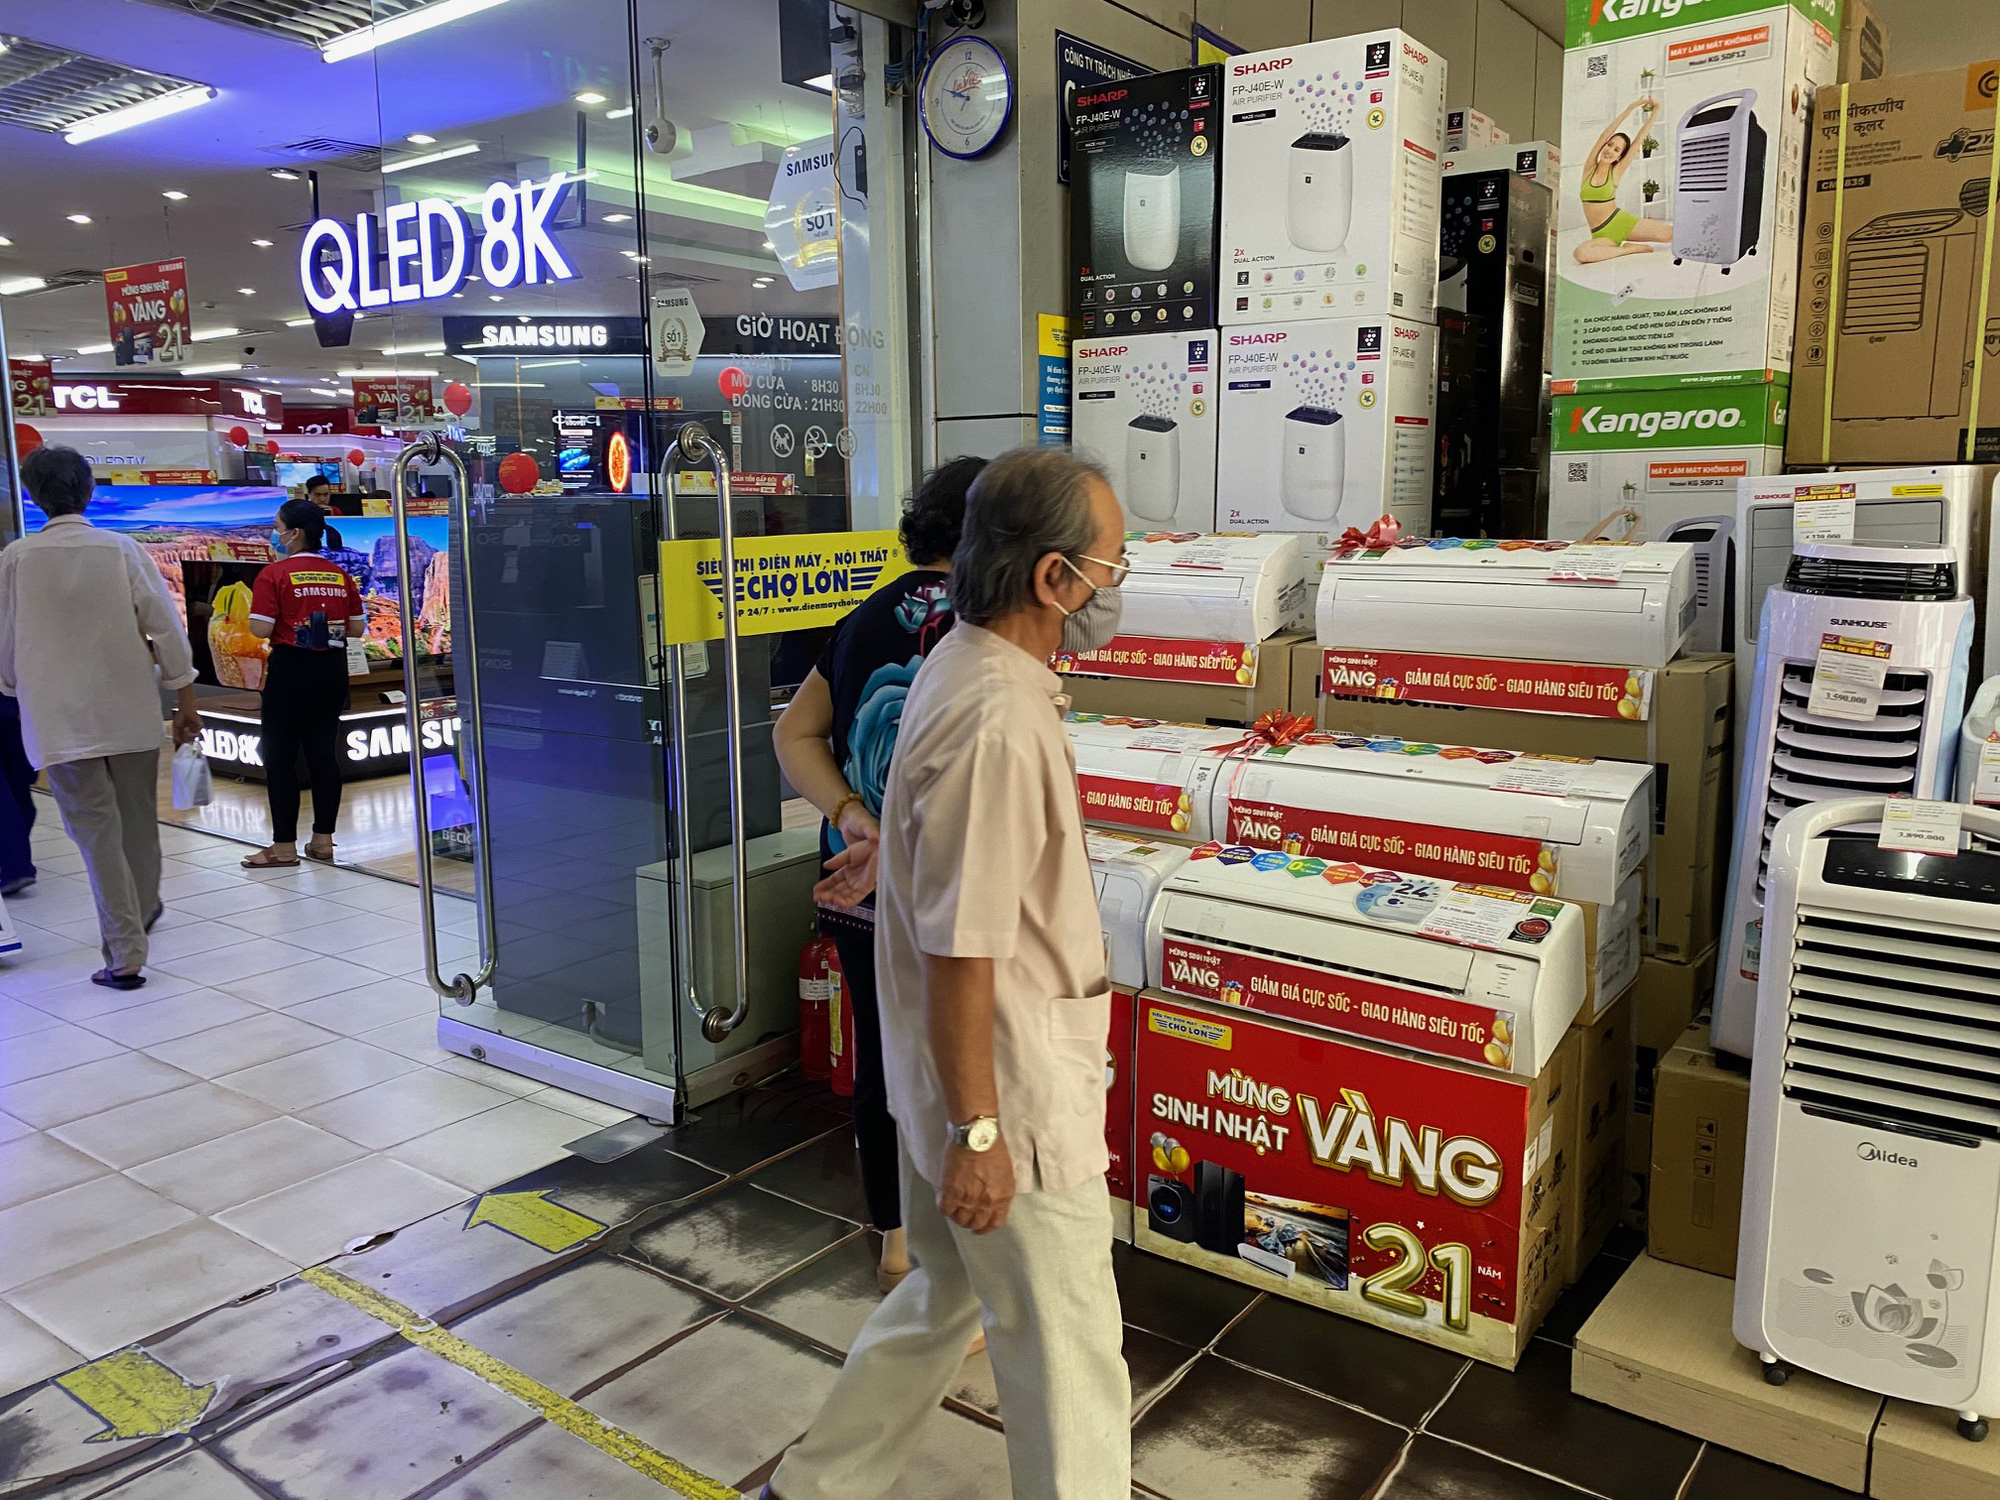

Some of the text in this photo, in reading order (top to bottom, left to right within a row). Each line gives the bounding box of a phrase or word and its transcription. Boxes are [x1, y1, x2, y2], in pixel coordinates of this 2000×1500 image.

[965, 51, 972, 60] 12
[1403, 43, 1428, 66] SHARP
[1233, 58, 1293, 77] SHARP
[1232, 79, 1285, 96] FP-J40E-W
[935, 98, 939, 107] 9
[1077, 89, 1128, 108] SHARP
[1232, 92, 1283, 107] AIR PURIFIER
[1076, 109, 1122, 125] FP-J40E-W
[965, 137, 970, 146] 6
[300, 172, 572, 313] QLED 8K
[1234, 249, 1245, 257] 2x
[1080, 267, 1091, 275] 2x
[1096, 273, 1116, 281] ACTION
[128, 296, 166, 322] VÀNG
[657, 298, 689, 309] SAMSUNG
[157, 322, 184, 362] 21
[482, 325, 608, 346] SAMSUNG
[666, 327, 682, 343] SỐ 1
[779, 320, 830, 347] HOẠT
[1229, 332, 1287, 346] SHARP
[1394, 327, 1420, 340] SHARP
[1078, 346, 1129, 359] SHARP
[1228, 352, 1279, 365] FP-J40E-W
[778, 358, 793, 372] T7
[1078, 365, 1122, 375] FP-J40E-W
[1228, 364, 1278, 374] AIR PURIFIER
[811, 378, 839, 394] 8H30
[1078, 375, 1121, 385] AIR PURIFIER
[17, 394, 46, 416] 21
[52, 386, 120, 409] TCL
[241, 391, 267, 416] TCL
[376, 390, 411, 404] VÀNG
[732, 392, 888, 415] ĐÓNG CỬA 21H30 22H00
[401, 405, 425, 423] 21
[1568, 406, 1741, 439] Kangaroo
[1651, 463, 1745, 475] MÁY LÀM MÁT KHÔNG KHÍ
[1688, 479, 1699, 487] KG
[1229, 509, 1241, 518] 2x
[1229, 517, 1246, 525] DUAL
[759, 554, 792, 574] ĐIỆN
[795, 551, 822, 569] MÁY
[834, 549, 857, 568] NỘI
[860, 546, 888, 563] THẤT
[294, 587, 348, 598] SAMSUNG
[747, 565, 849, 603] CHỢ LỚN
[1830, 618, 1888, 629] SUNHOUSE
[1098, 648, 1113, 663] GIÁ
[1113, 651, 1129, 666] CỰC
[1130, 648, 1147, 666] SỐC
[1153, 653, 1173, 667] GIAO
[1174, 651, 1198, 668] HÀNG
[1199, 654, 1218, 670] SIÊU
[1221, 654, 1237, 671] TỐC
[1328, 666, 1377, 687] VÀNG
[1405, 667, 1619, 702] GIẢM GIÁ CỰC SỐC GIAO HÀNG SIÊU TỐC
[1825, 692, 1867, 705] 3.590.000
[238, 734, 264, 767] 8K
[1086, 791, 1173, 816] GIAO HÀNG SIÊU TỐC
[1267, 810, 1283, 821] NHẬT
[1310, 824, 1531, 876] GIẢM GIÁ CỰC SỐC GIAO HÀNG SIÊU TỐC
[1394, 883, 1430, 898] 24
[1169, 947, 1222, 967] MỪNG SINH NHẬT
[1168, 958, 1220, 989] VÀNG
[1250, 974, 1486, 1045] GIẢM GIÁ CỰC SỐC GIAO HÀNG SIÊU TỐC
[1206, 1067, 1292, 1116] MỪNG
[1151, 1092, 1291, 1157] SINH NHẬT
[1296, 1087, 1503, 1208] VÀNG
[1857, 1141, 1919, 1169] Midea
[1360, 1222, 1472, 1332] 21
[1477, 1265, 1503, 1281] NĂM
